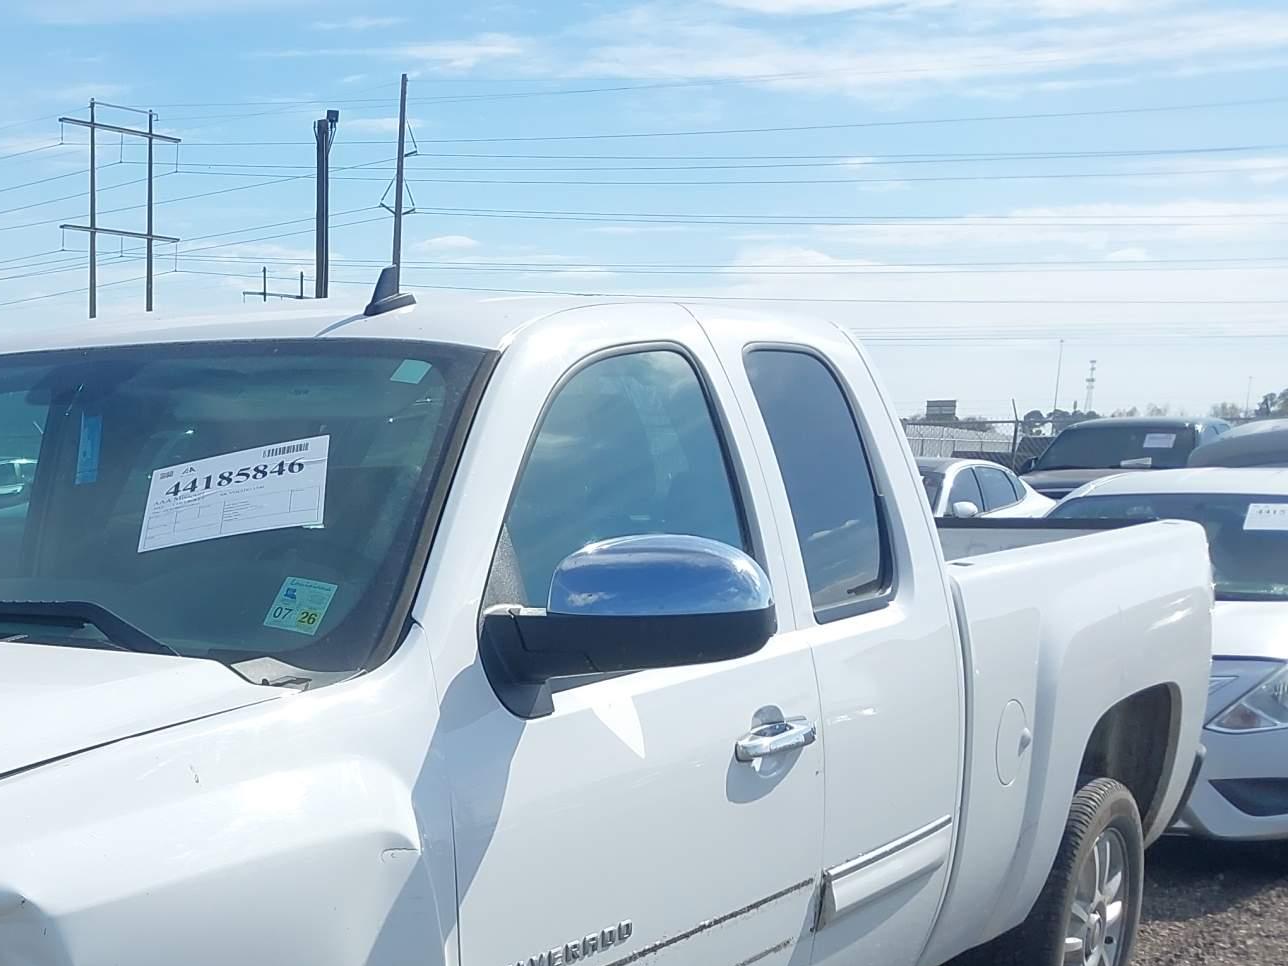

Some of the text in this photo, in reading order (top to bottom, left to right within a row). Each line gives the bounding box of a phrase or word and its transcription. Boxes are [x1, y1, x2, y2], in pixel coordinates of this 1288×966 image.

[165, 457, 305, 496] 44185846
[273, 606, 293, 620] 07
[298, 611, 318, 625] 26
